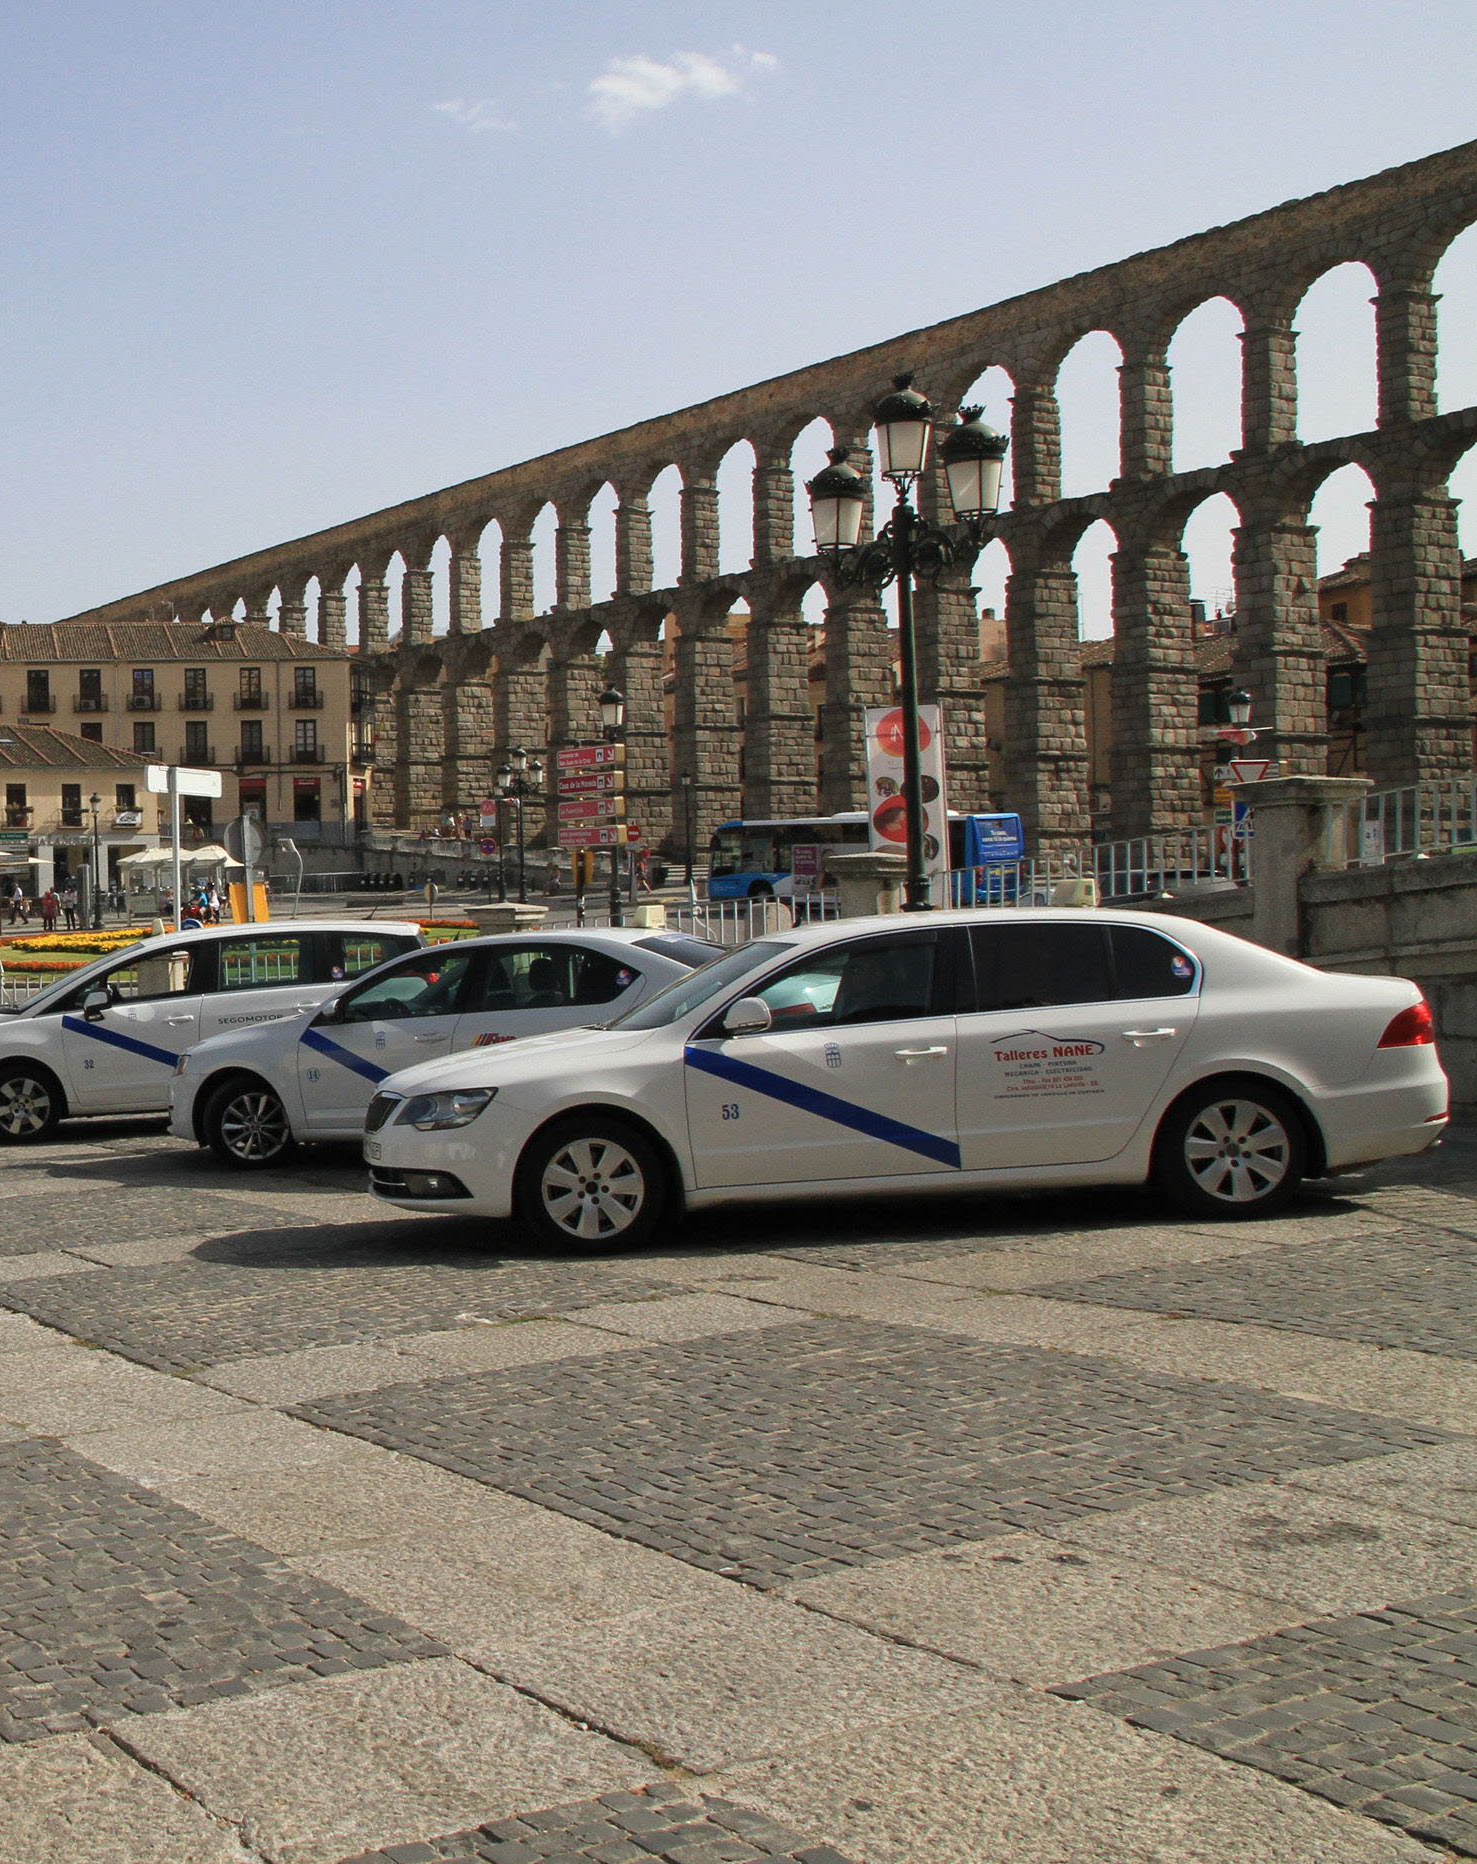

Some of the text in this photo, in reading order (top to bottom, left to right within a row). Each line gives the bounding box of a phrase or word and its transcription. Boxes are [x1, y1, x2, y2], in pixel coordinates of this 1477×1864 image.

[218, 1014, 284, 1025] SEGOMOTOR
[994, 1044, 1094, 1062] Talleres NANE
[84, 1059, 95, 1070] 32
[722, 1104, 739, 1120] 53
